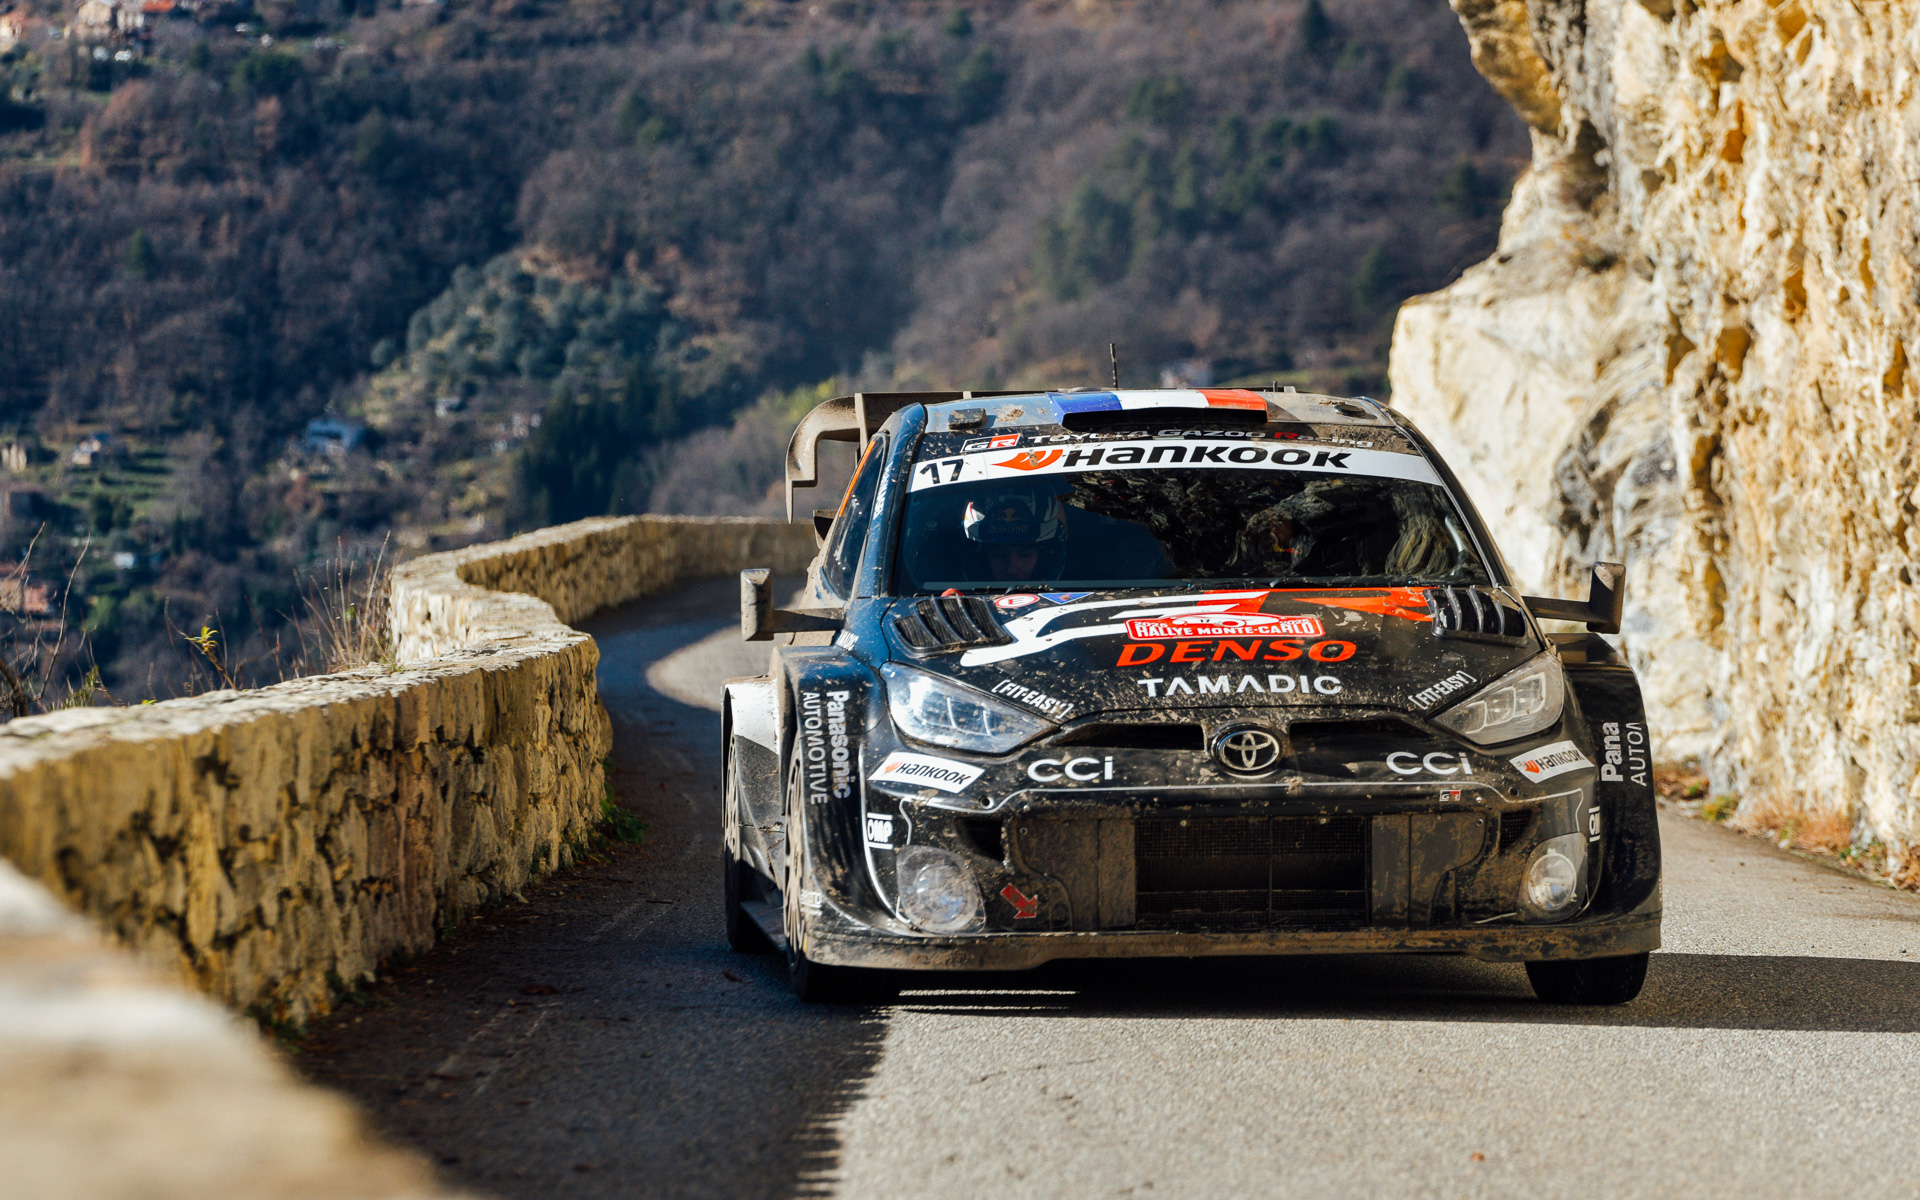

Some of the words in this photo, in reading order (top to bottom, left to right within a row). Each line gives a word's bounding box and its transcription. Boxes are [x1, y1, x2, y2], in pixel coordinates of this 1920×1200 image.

[964, 436, 1018, 451] GR
[1157, 429, 1266, 438] GAZOO
[1274, 431, 1373, 447] Racing
[1062, 445, 1352, 468] HanKOOK
[920, 458, 964, 485] 17
[1136, 624, 1193, 637] RALLYE
[1199, 621, 1315, 635] MONTE-CARLO
[1116, 639, 1357, 667] DENSO
[1137, 674, 1343, 697] TAMADIC
[802, 691, 828, 805] AUTOMOTIVE
[826, 690, 851, 799] Panasonic
[1601, 722, 1624, 783] Pana
[867, 820, 893, 843] OMP
